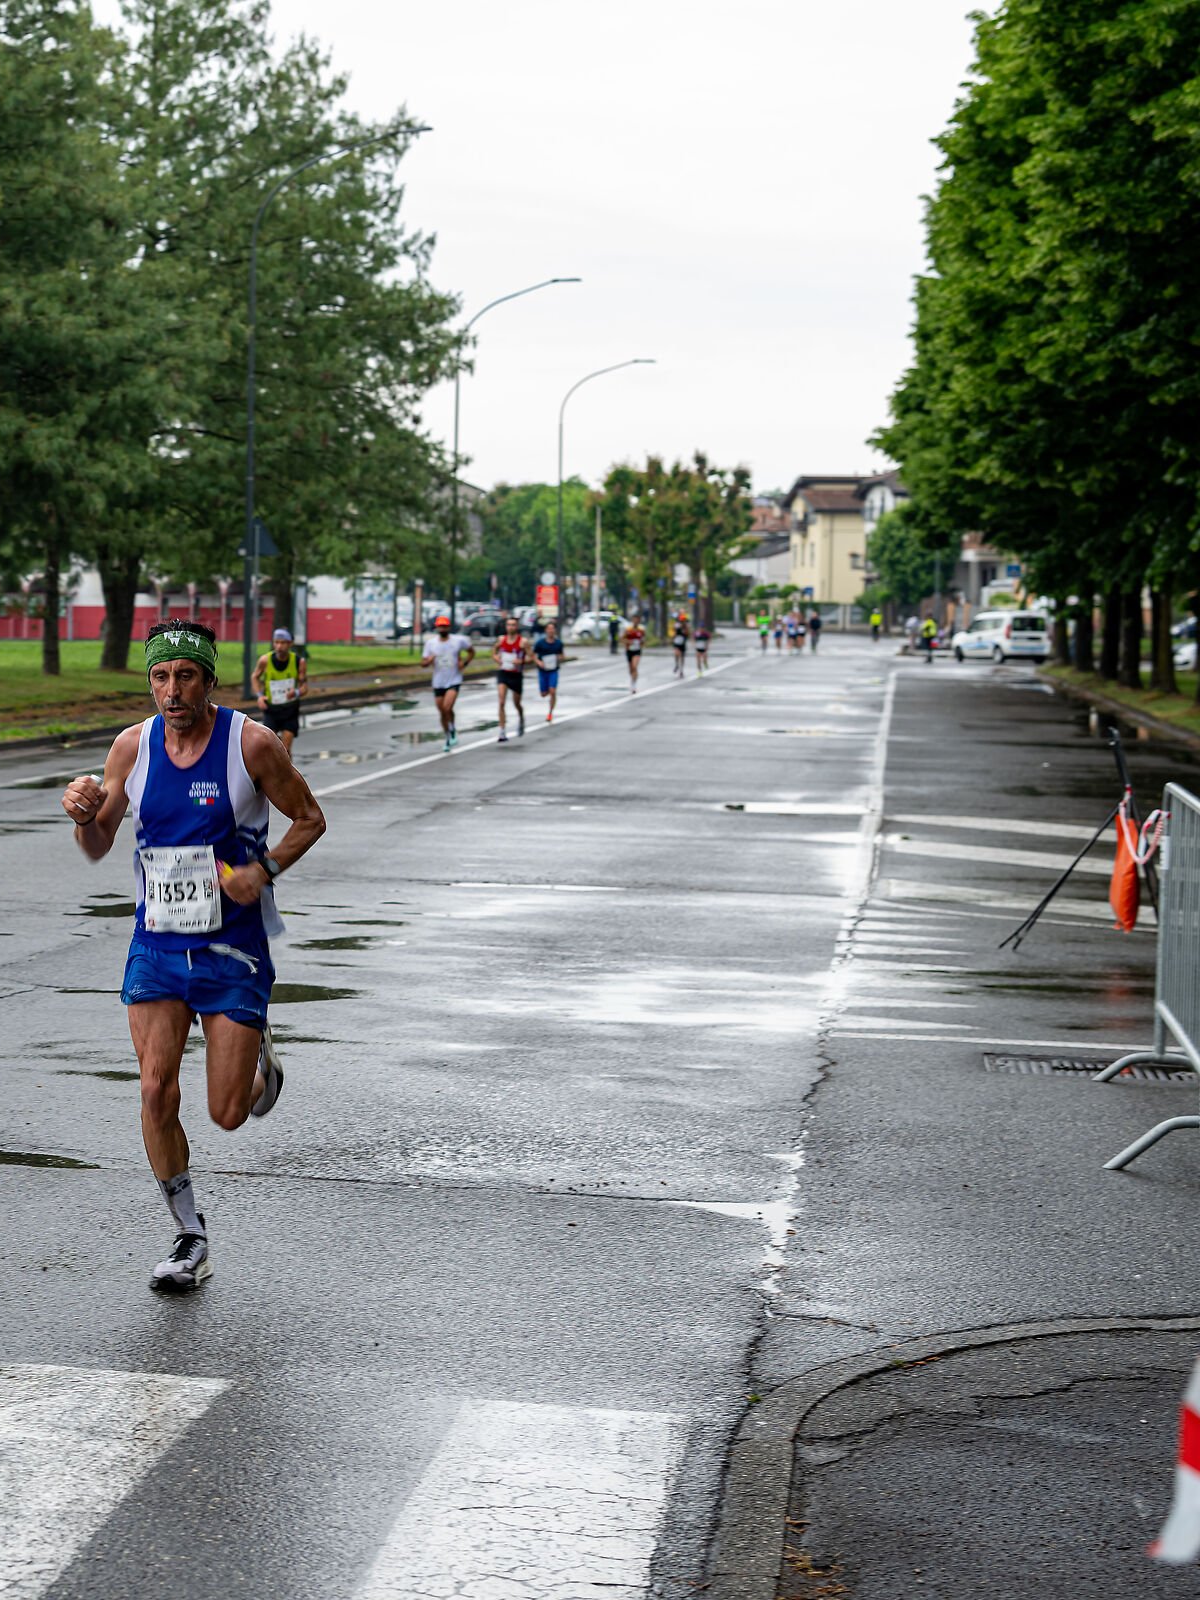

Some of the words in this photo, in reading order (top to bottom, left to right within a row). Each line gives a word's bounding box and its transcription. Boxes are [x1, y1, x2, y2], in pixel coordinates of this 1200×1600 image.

[191, 781, 218, 790] CORNO
[188, 789, 220, 798] GIOVINE
[158, 881, 198, 903] 1352
